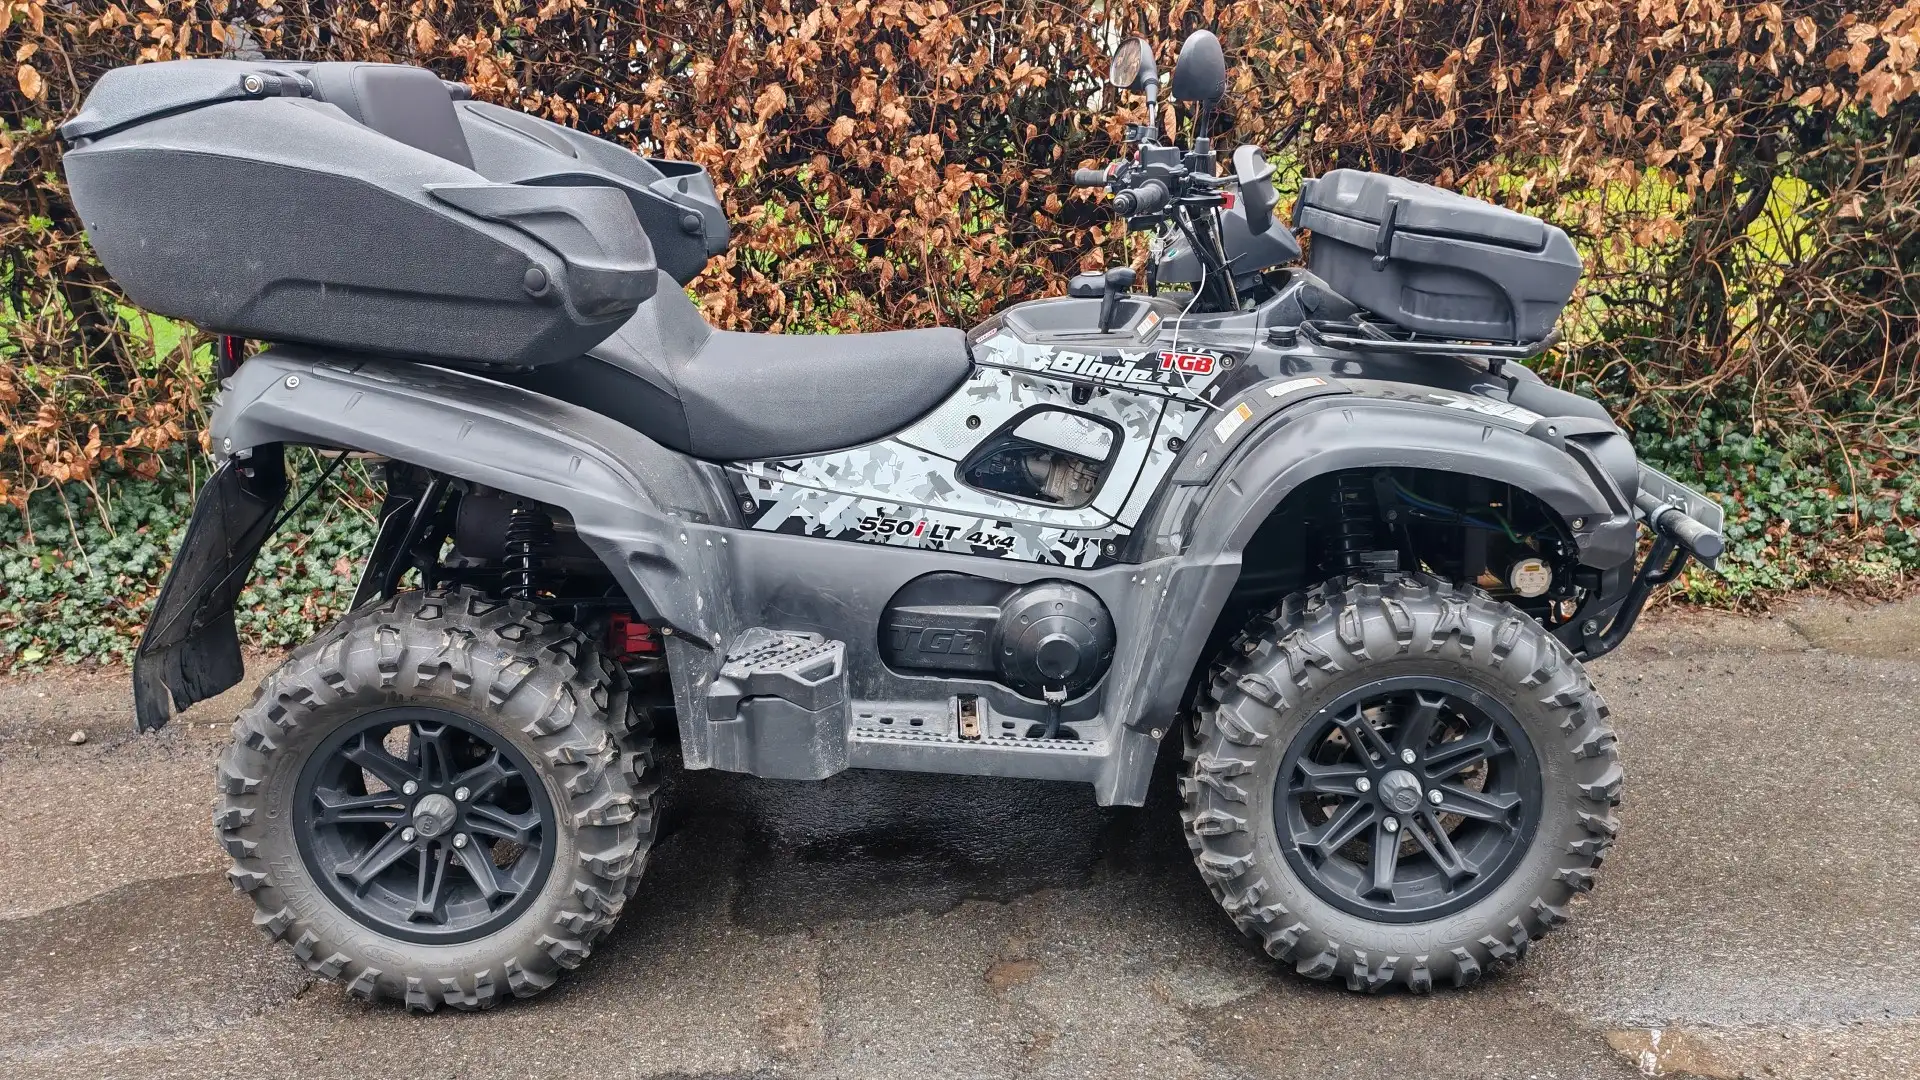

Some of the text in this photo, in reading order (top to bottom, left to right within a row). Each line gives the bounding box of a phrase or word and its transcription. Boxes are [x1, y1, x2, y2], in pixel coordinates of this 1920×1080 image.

[1049, 351, 1152, 383] Blade
[1159, 352, 1214, 374] TGB
[859, 516, 1016, 548] 550i LT 4x4
[889, 624, 987, 655] TGB
